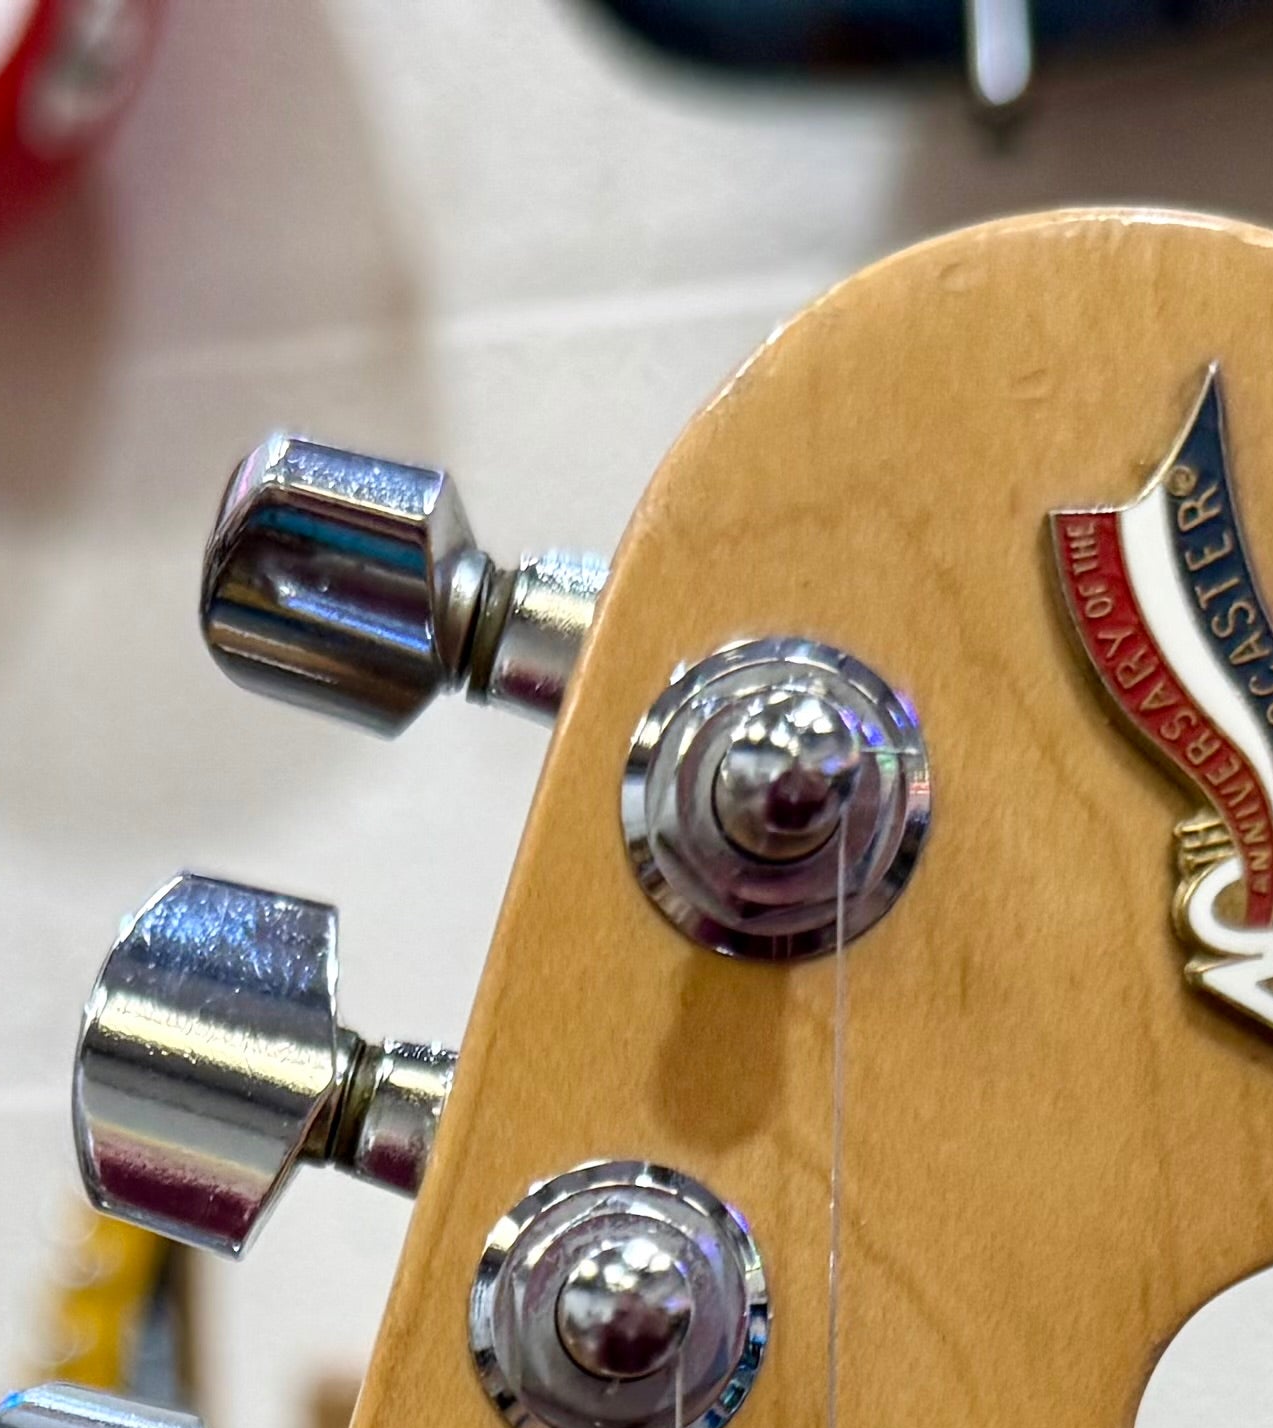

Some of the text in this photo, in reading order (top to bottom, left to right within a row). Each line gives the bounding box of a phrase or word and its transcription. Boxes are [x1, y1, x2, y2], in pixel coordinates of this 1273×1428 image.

[1066, 520, 1272, 895] ANNIVERSARY OF THE
